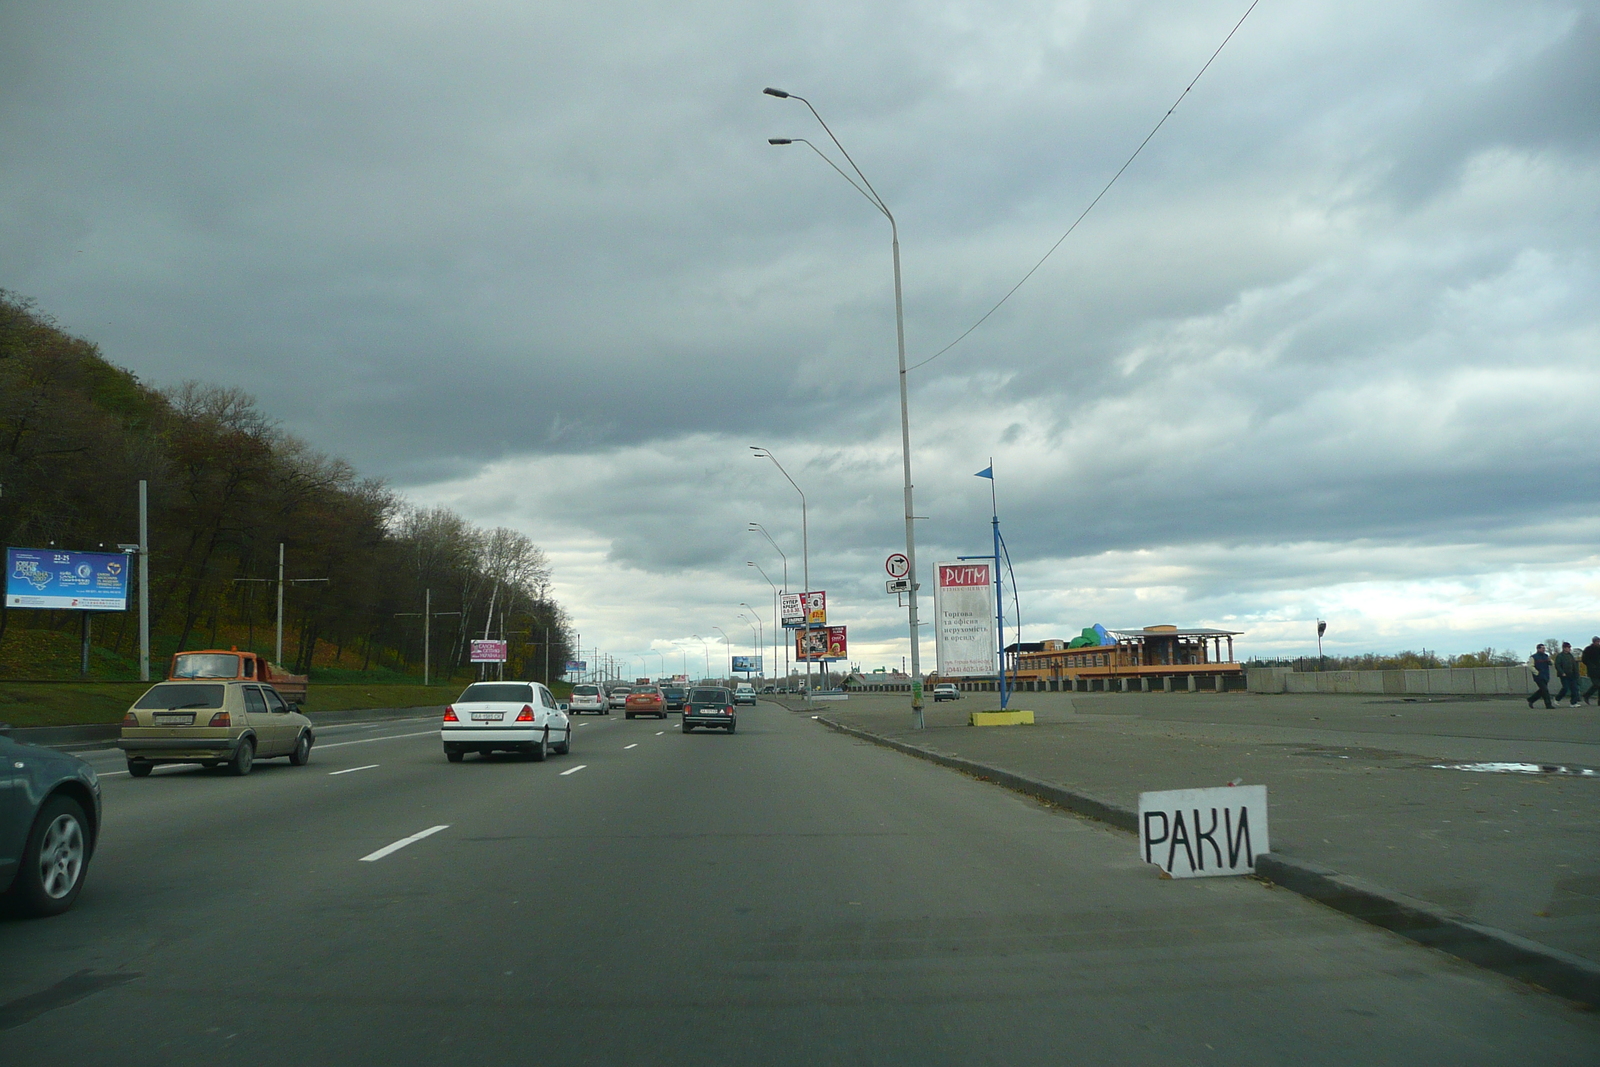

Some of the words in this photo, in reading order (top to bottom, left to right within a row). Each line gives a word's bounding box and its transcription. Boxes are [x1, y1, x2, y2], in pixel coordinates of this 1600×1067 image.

[945, 567, 986, 586] РИТМ
[943, 610, 973, 618] Торгова
[953, 618, 979, 626] офісна
[950, 634, 976, 642] оренду
[1144, 806, 1253, 872] РАКИ
